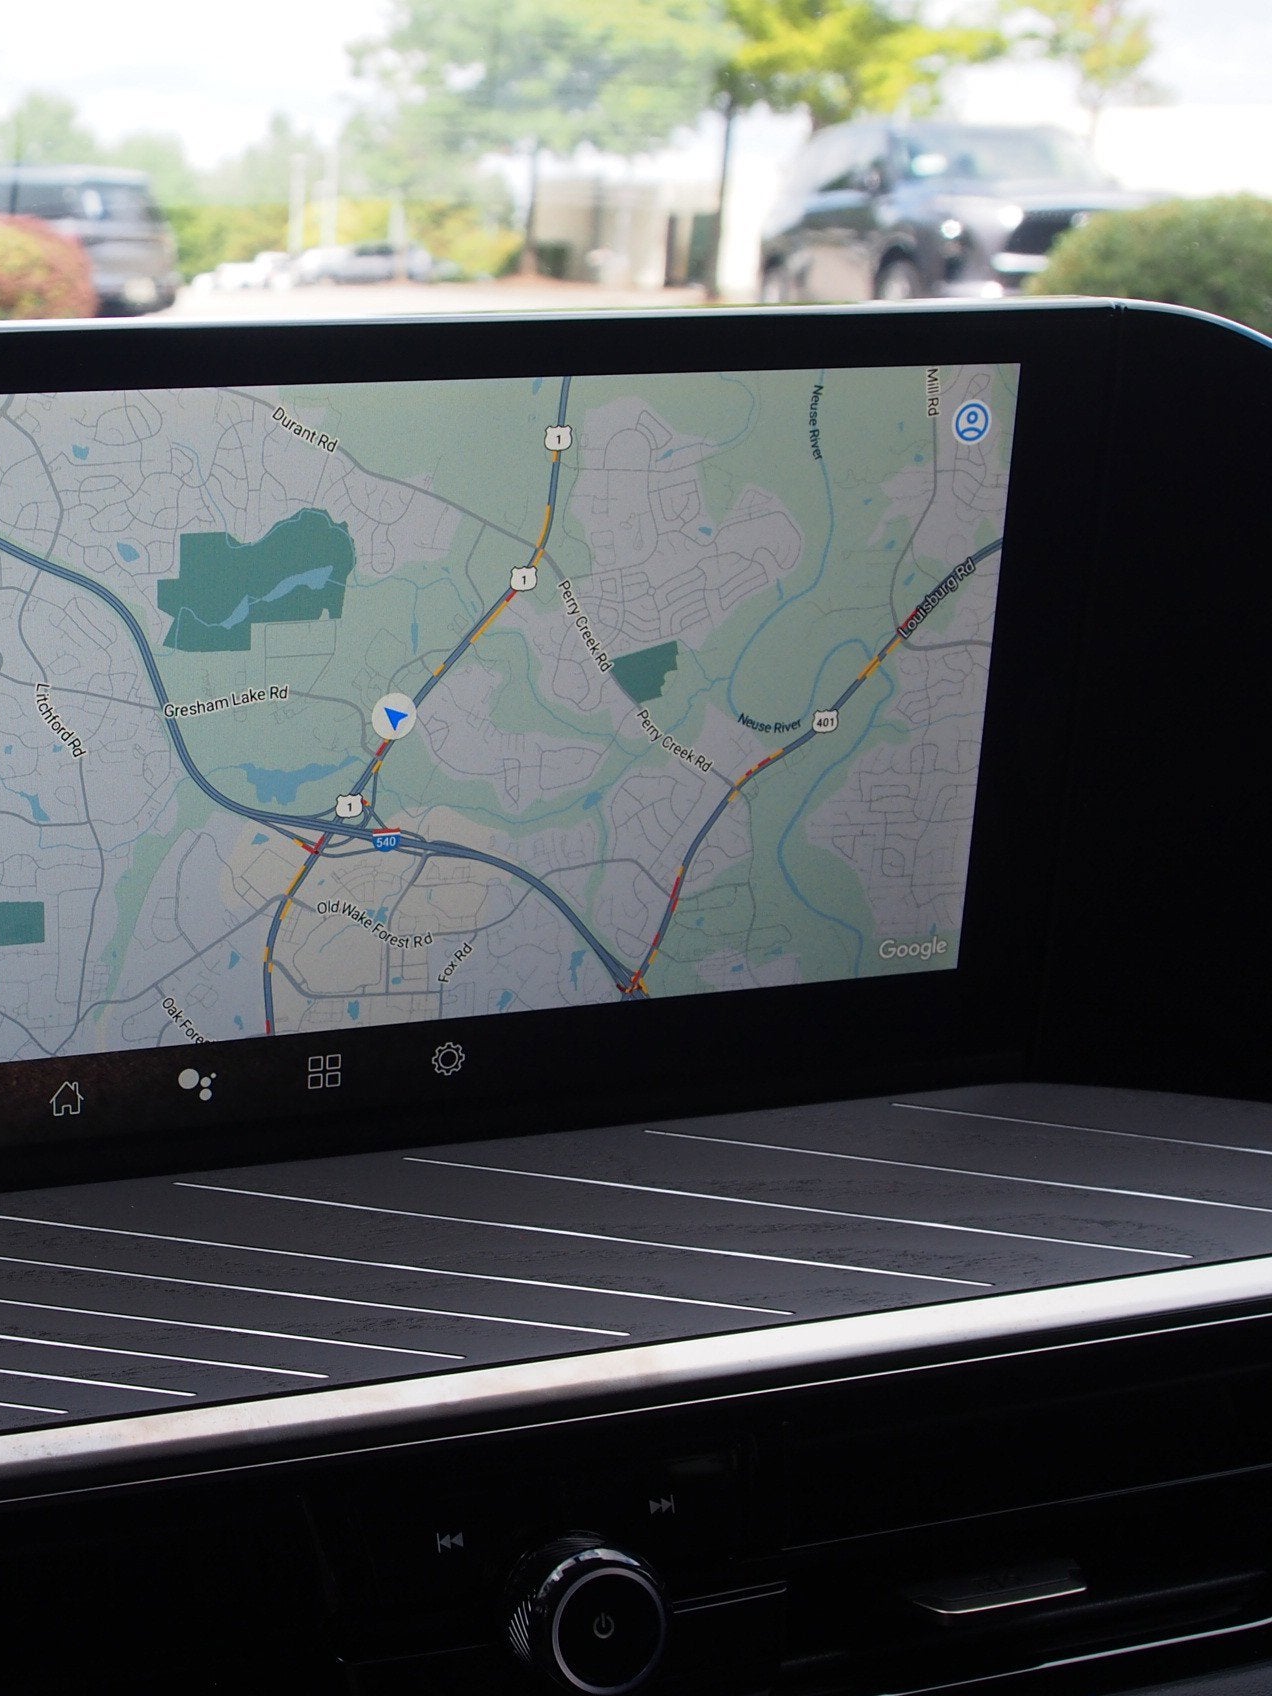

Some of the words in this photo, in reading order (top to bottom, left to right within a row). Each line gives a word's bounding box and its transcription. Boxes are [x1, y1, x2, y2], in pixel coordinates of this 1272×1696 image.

[927, 368, 939, 394] Mill
[809, 384, 824, 426] Neuse
[928, 397, 940, 417] Rd
[272, 407, 313, 443] Durant
[314, 434, 338, 453] Rd
[809, 429, 823, 461] River
[898, 576, 958, 639] Louisburg
[955, 557, 976, 582] Rd
[558, 580, 579, 615] Perry
[576, 616, 601, 656] Creek
[595, 653, 612, 673] Rd
[36, 683, 75, 742] Litchford
[68, 737, 86, 758] Rd
[164, 697, 229, 718] Gresham
[231, 689, 267, 707] Lake
[269, 686, 289, 700] Rd
[817, 717, 835, 728] 401
[637, 710, 662, 743] Perry
[662, 736, 695, 763] Creek
[694, 755, 713, 773] Rd
[738, 713, 771, 733] Neuse
[774, 718, 802, 733] River
[376, 837, 396, 847] 540
[317, 900, 340, 914] Old
[342, 904, 372, 929] Wake
[372, 923, 409, 949] Forest
[414, 932, 434, 948] Rd
[438, 961, 457, 984] Fox
[454, 943, 473, 962] Rd
[879, 936, 947, 961] Google
[162, 998, 183, 1023] Oak
[180, 1020, 215, 1044] Fore
